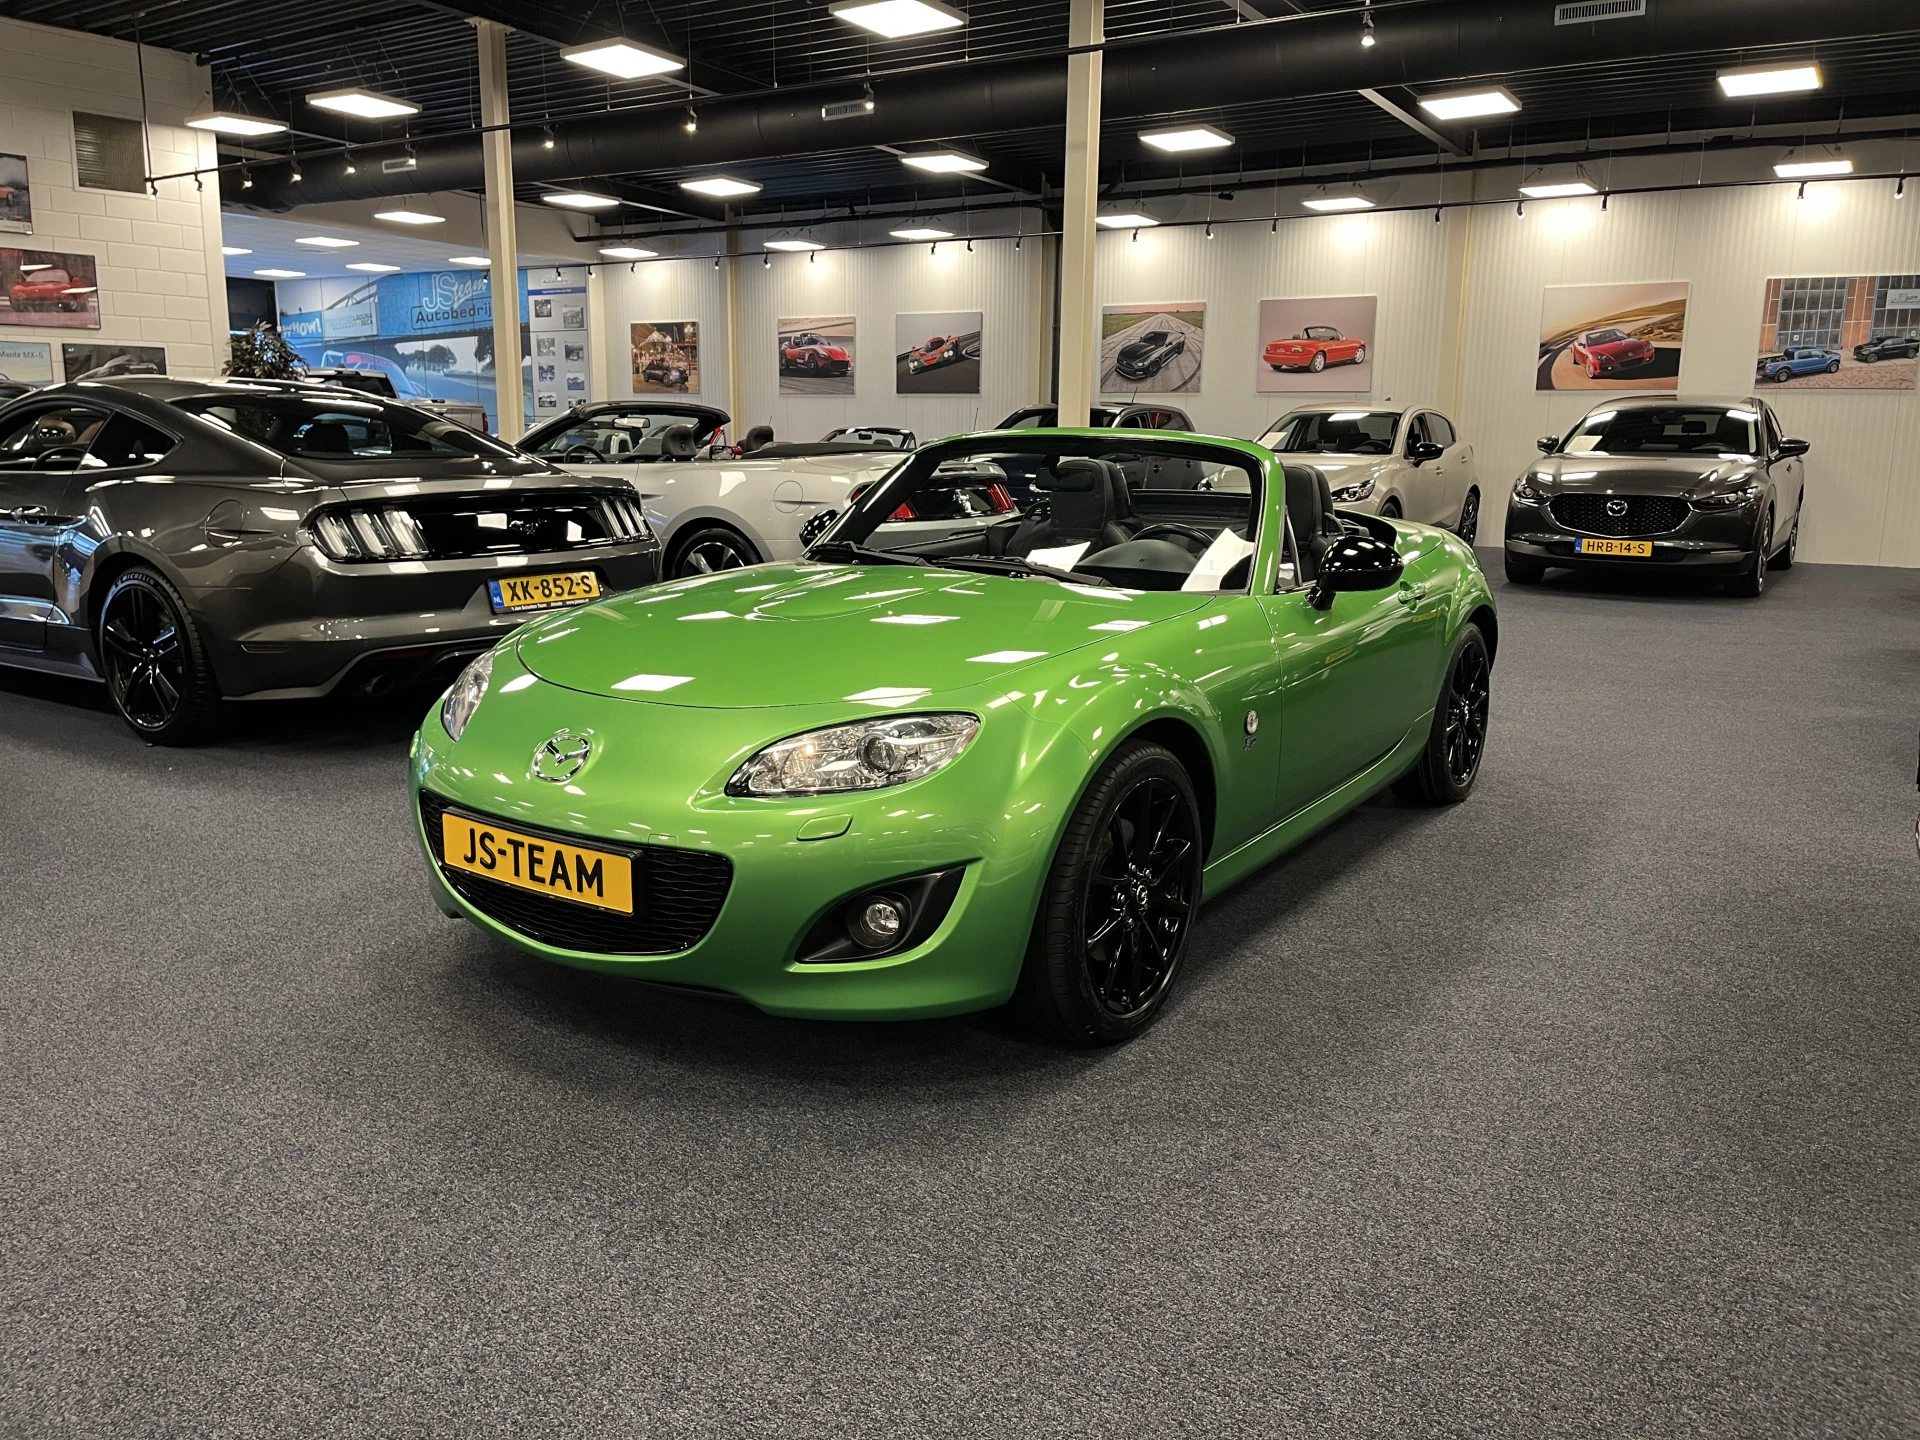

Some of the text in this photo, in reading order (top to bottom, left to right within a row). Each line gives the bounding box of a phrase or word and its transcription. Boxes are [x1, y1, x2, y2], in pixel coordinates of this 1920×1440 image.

[23, 351, 44, 359] MX-5
[1586, 541, 1646, 554] HRB-14-S
[122, 573, 155, 586] MICHELIN
[506, 575, 593, 602] XK-852-S
[493, 596, 503, 604] NL
[463, 827, 604, 898] JS-TEAM
